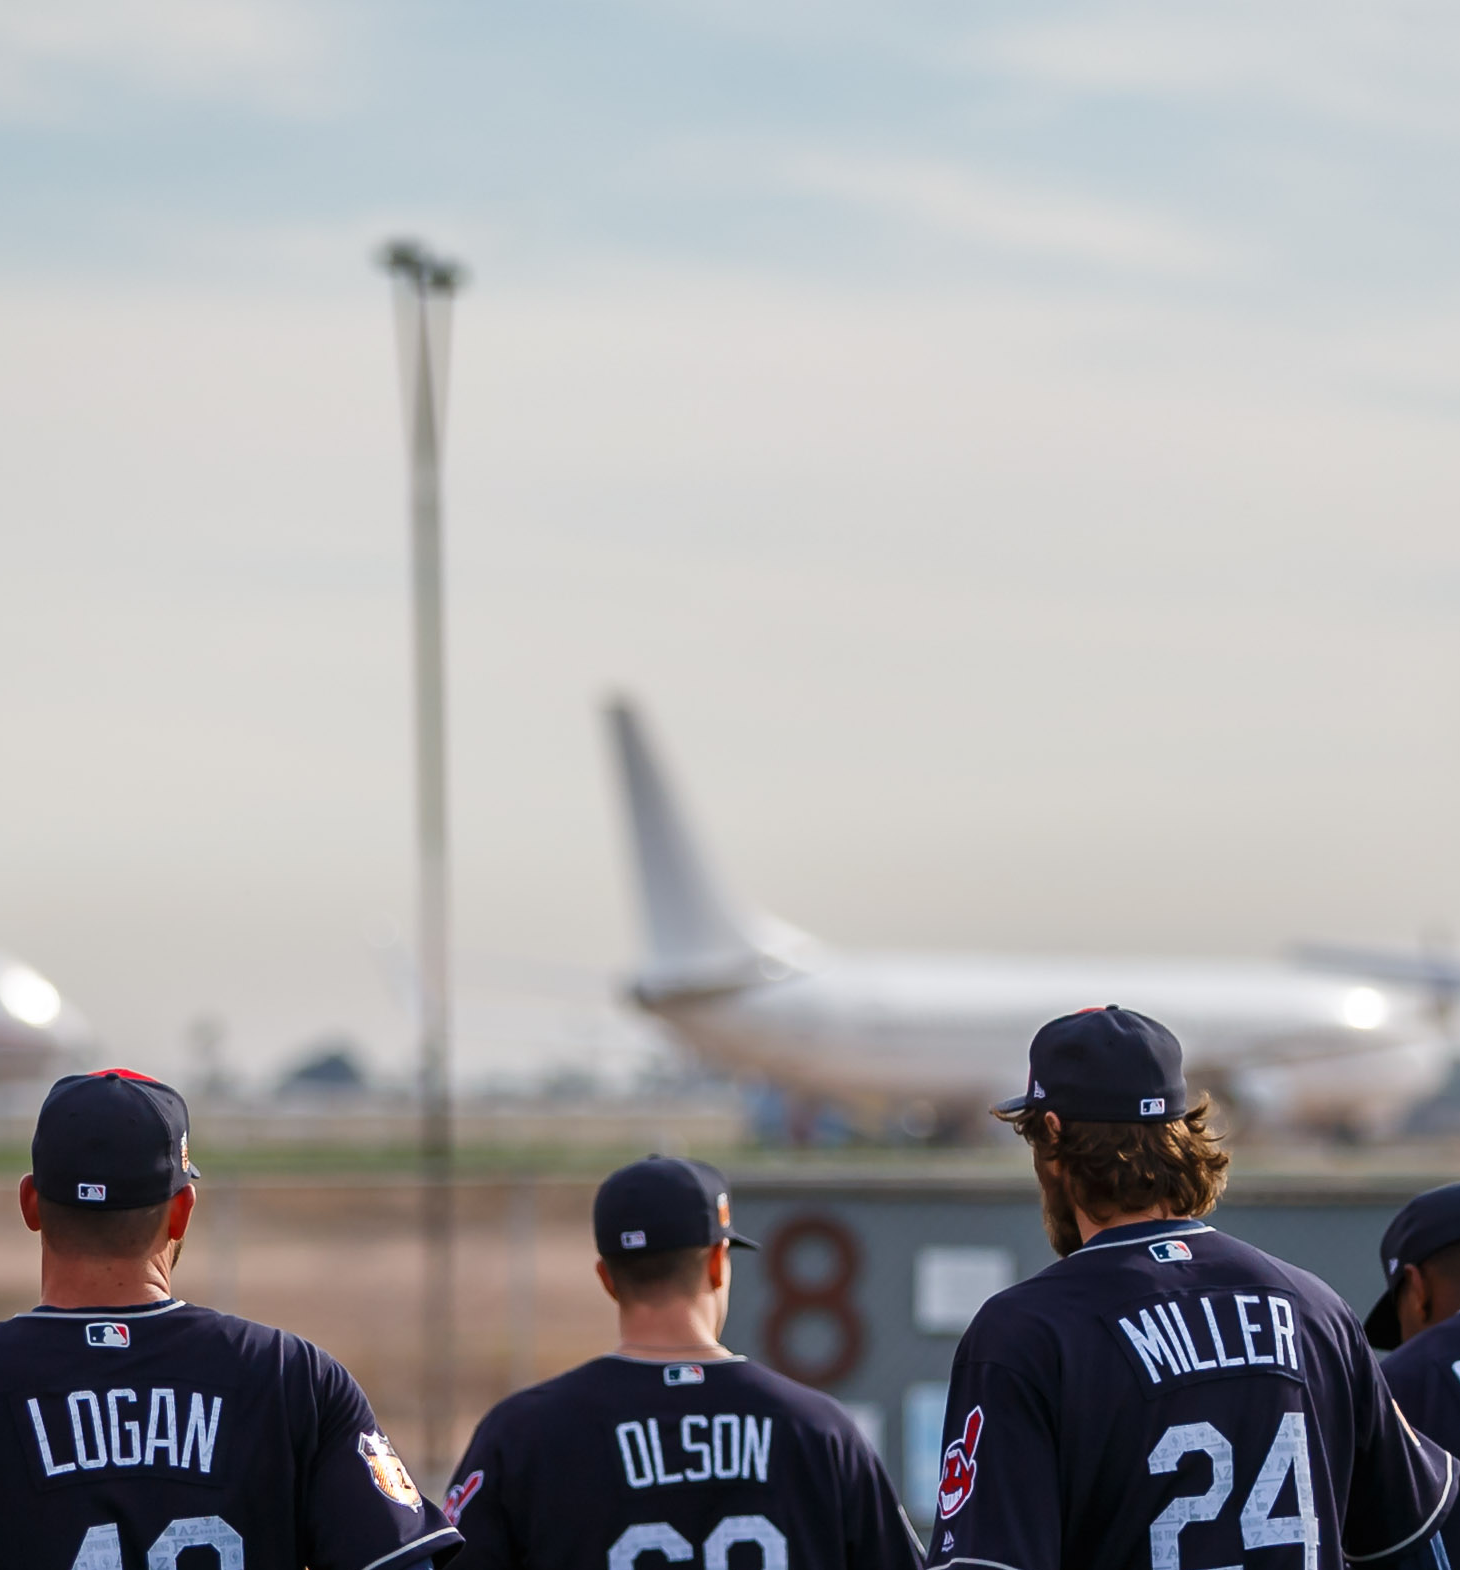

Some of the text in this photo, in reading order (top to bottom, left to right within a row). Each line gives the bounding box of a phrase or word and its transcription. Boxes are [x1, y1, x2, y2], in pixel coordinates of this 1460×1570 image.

[763, 1214, 866, 1387] 8
[1118, 1293, 1300, 1385] MILLER
[26, 1387, 223, 1478] LOGAN
[615, 1414, 773, 1489] OLSON
